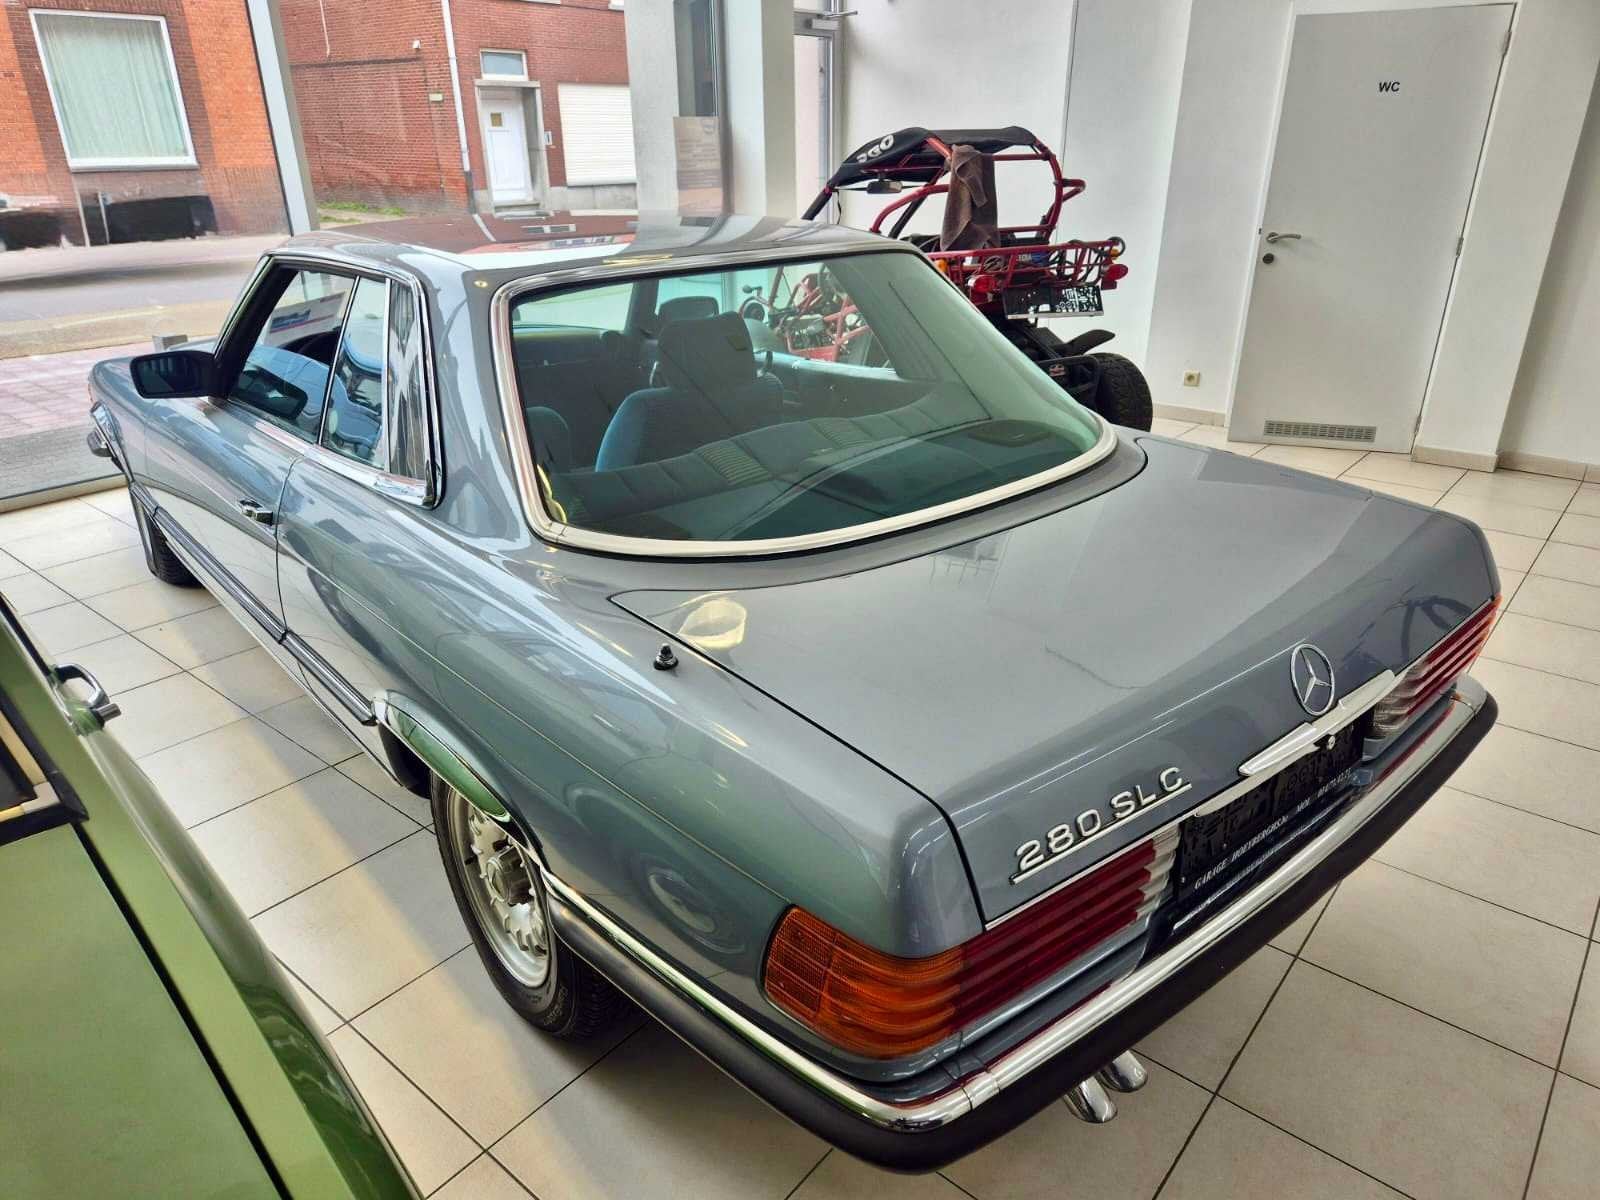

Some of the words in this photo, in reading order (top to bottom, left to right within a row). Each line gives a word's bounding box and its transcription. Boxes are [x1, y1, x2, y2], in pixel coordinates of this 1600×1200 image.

[1379, 81, 1401, 93] WC
[1016, 808, 1101, 872] 280
[1110, 766, 1184, 819] SLC
[1195, 857, 1228, 890] GARAGE
